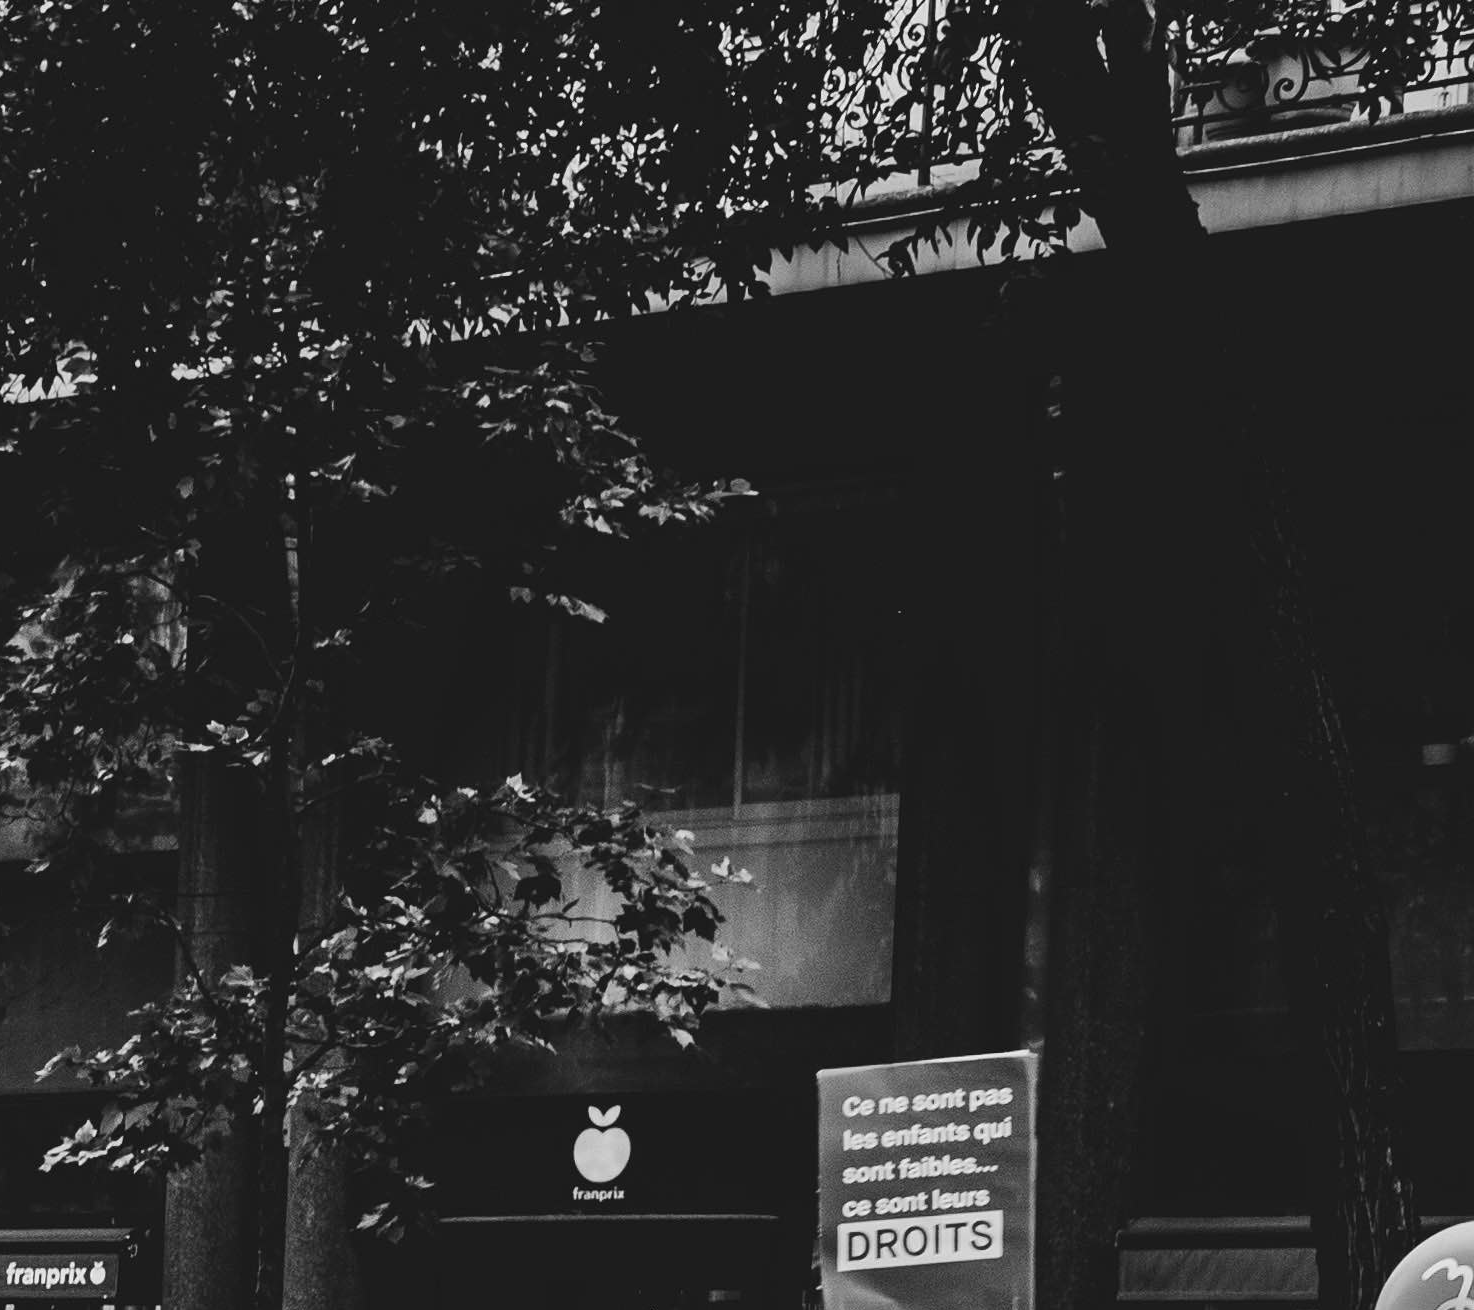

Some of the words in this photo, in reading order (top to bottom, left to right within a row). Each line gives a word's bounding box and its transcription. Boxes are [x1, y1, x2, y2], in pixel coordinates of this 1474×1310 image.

[842, 1095, 876, 1118] Ce
[878, 1095, 909, 1115] ne
[912, 1088, 966, 1112] sont
[969, 1087, 1014, 1112] pas
[842, 1129, 879, 1151] les
[881, 1122, 971, 1148] enfants
[973, 1116, 1013, 1145] qui
[842, 1160, 896, 1185] sont
[898, 1154, 999, 1180] faibles...
[573, 1186, 625, 1203] franprix
[842, 1199, 873, 1218] ce
[875, 1191, 929, 1216] sont
[931, 1188, 991, 1211] leurs
[847, 1220, 994, 1263] DROITS
[6, 1261, 87, 1290] franprix
